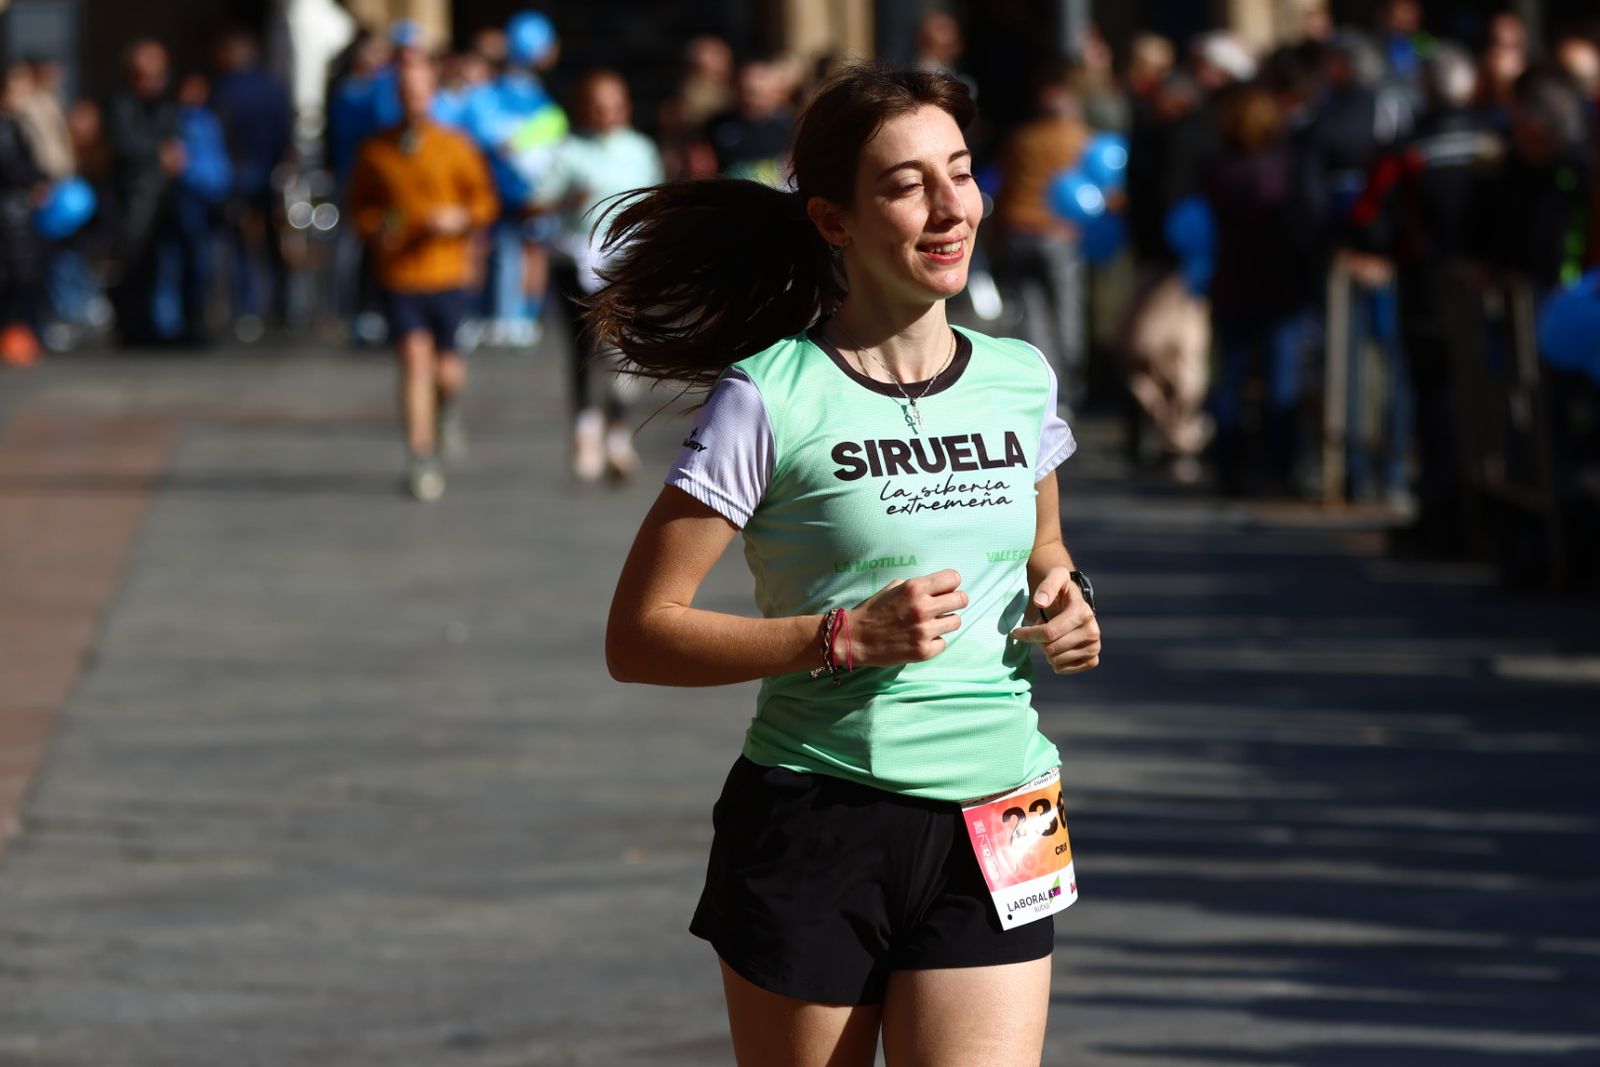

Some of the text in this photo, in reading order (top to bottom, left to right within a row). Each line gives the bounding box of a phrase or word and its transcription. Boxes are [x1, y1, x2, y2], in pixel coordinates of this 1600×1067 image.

[831, 431, 1028, 481] SIRUELA
[920, 474, 1010, 496] siberia
[886, 491, 1013, 516] extremeña
[833, 554, 918, 573] LA MOTILLA
[1007, 891, 1048, 912] LABORAL
